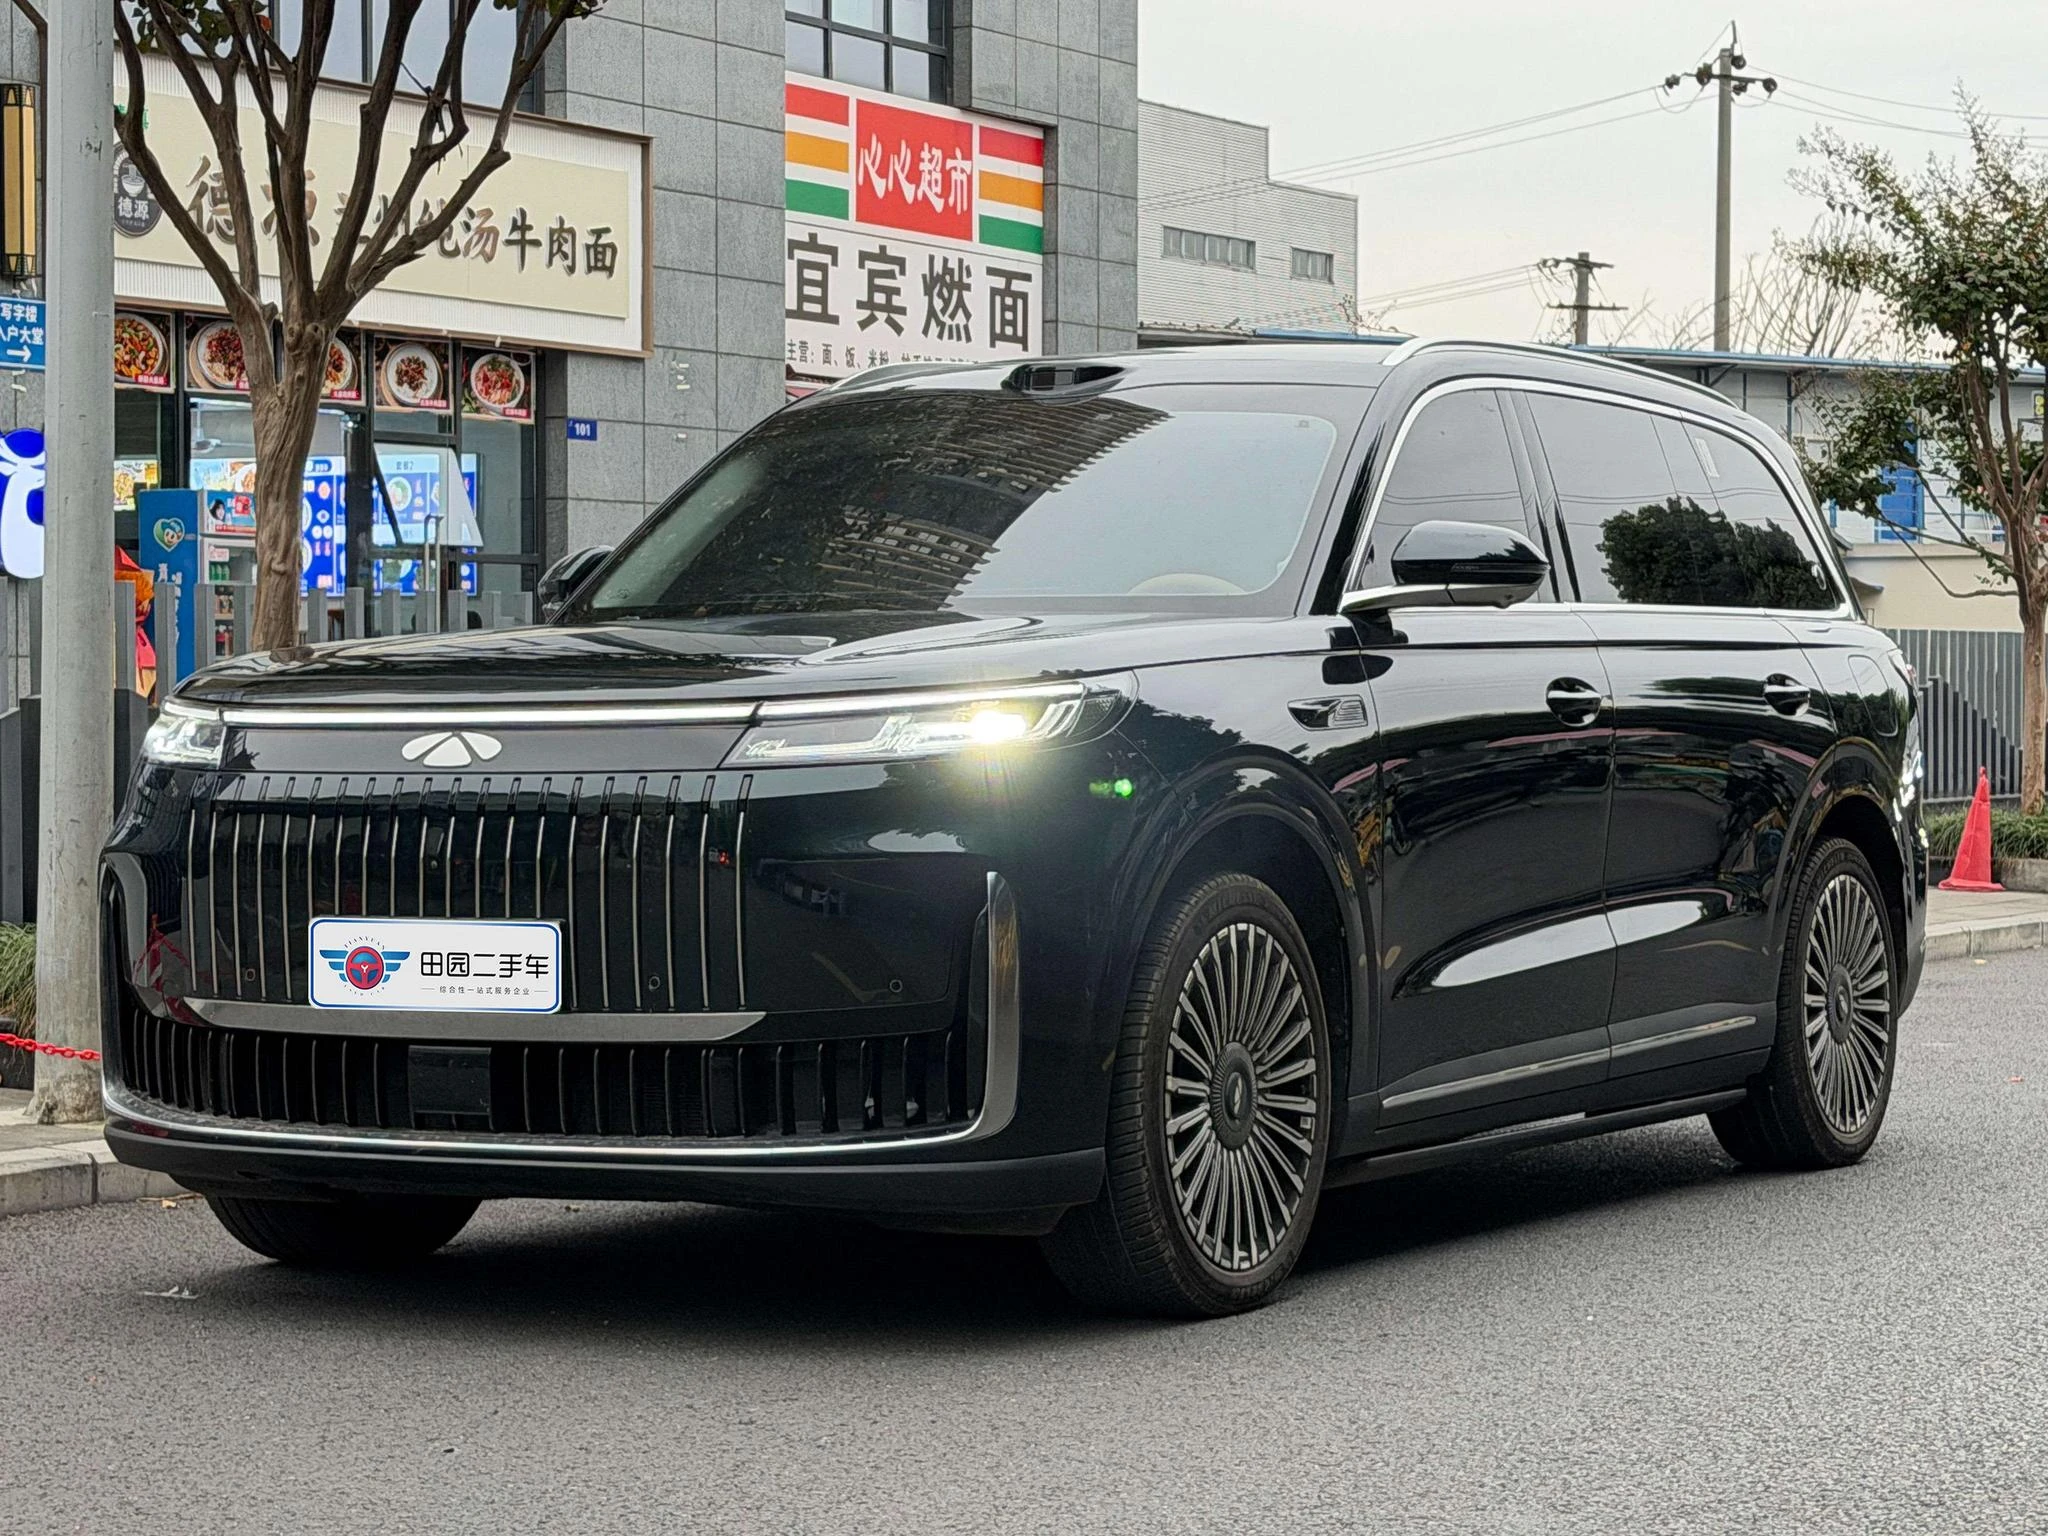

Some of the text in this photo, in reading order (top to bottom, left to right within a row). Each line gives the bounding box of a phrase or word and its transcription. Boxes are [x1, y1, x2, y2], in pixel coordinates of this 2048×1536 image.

[858, 133, 972, 215] 心心超市
[118, 196, 149, 220] 德源
[786, 232, 1032, 352] 宜宾燃面
[0, 302, 37, 323] 写字楼
[574, 422, 591, 437] 101
[421, 951, 549, 979] 田园二手车
[439, 985, 530, 996] 综合性一站式服务企业
